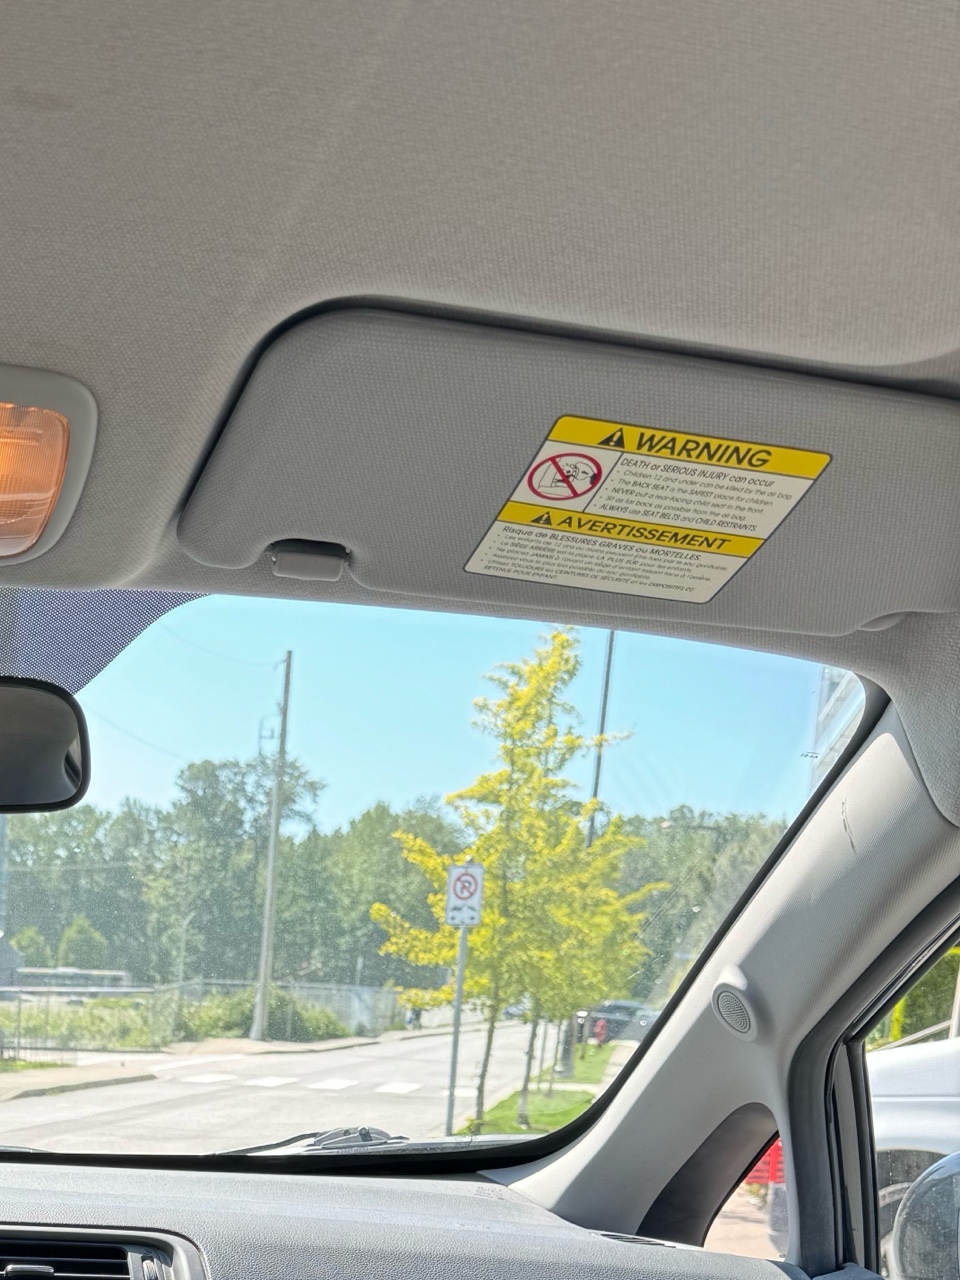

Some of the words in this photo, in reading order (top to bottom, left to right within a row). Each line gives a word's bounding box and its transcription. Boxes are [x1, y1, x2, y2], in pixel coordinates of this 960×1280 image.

[635, 431, 772, 468] WARNING
[620, 458, 650, 468] DEATH
[660, 464, 697, 475] SERIOUS
[697, 469, 729, 480] INJURY
[728, 475, 747, 483] can
[747, 478, 774, 486] occur
[500, 525, 535, 537] Risque
[548, 532, 599, 546] BLESSURES
[597, 540, 636, 551] GRAVES
[557, 514, 731, 550] AVERTISSEMENT
